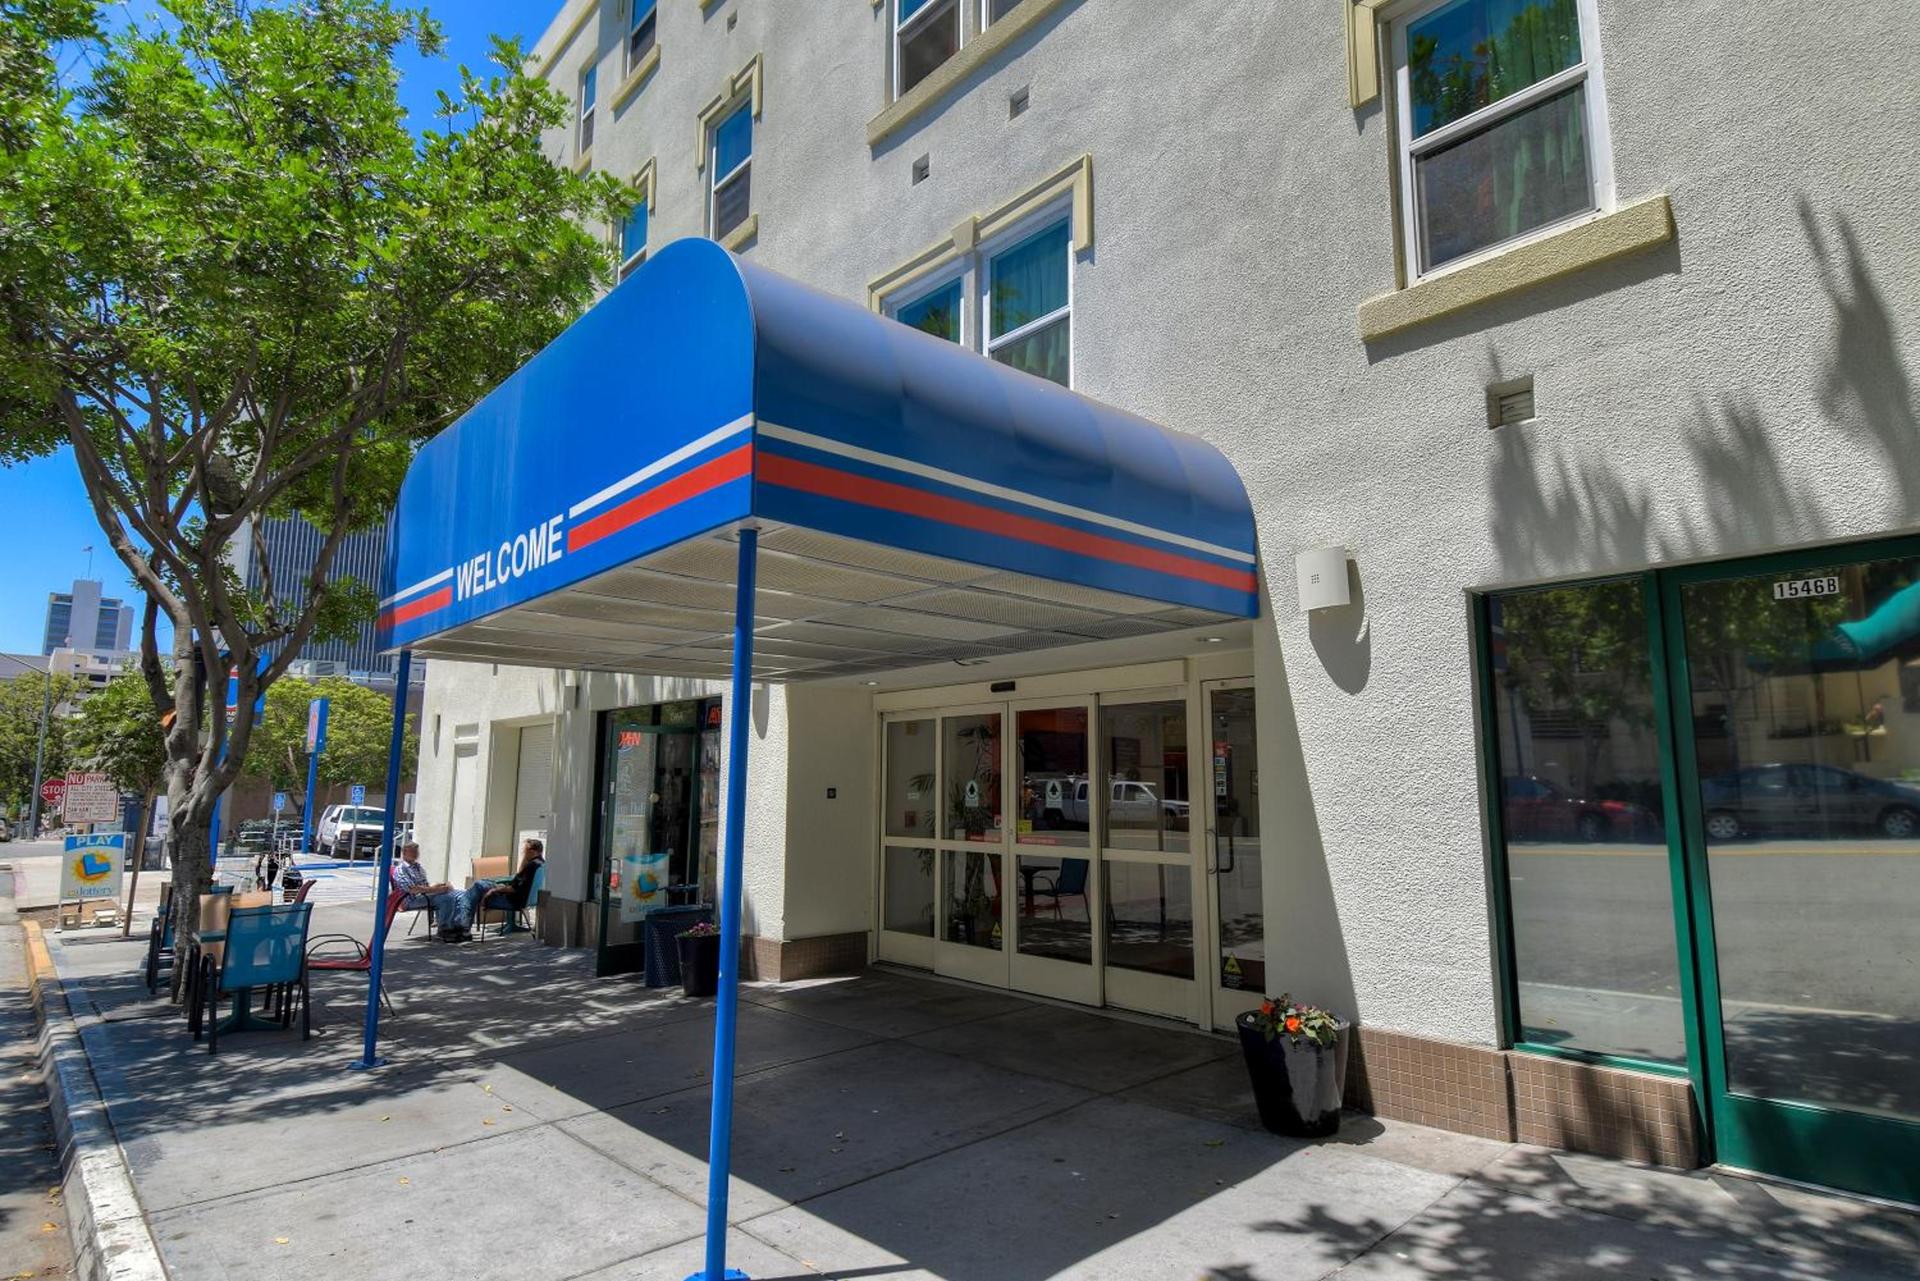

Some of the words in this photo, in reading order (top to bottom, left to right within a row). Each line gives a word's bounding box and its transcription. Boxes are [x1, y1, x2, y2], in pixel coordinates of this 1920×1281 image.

[457, 514, 564, 602] WELCOME
[1777, 578, 1837, 598] 1546B
[68, 773, 84, 784] NO
[76, 834, 112, 846] PLAY
